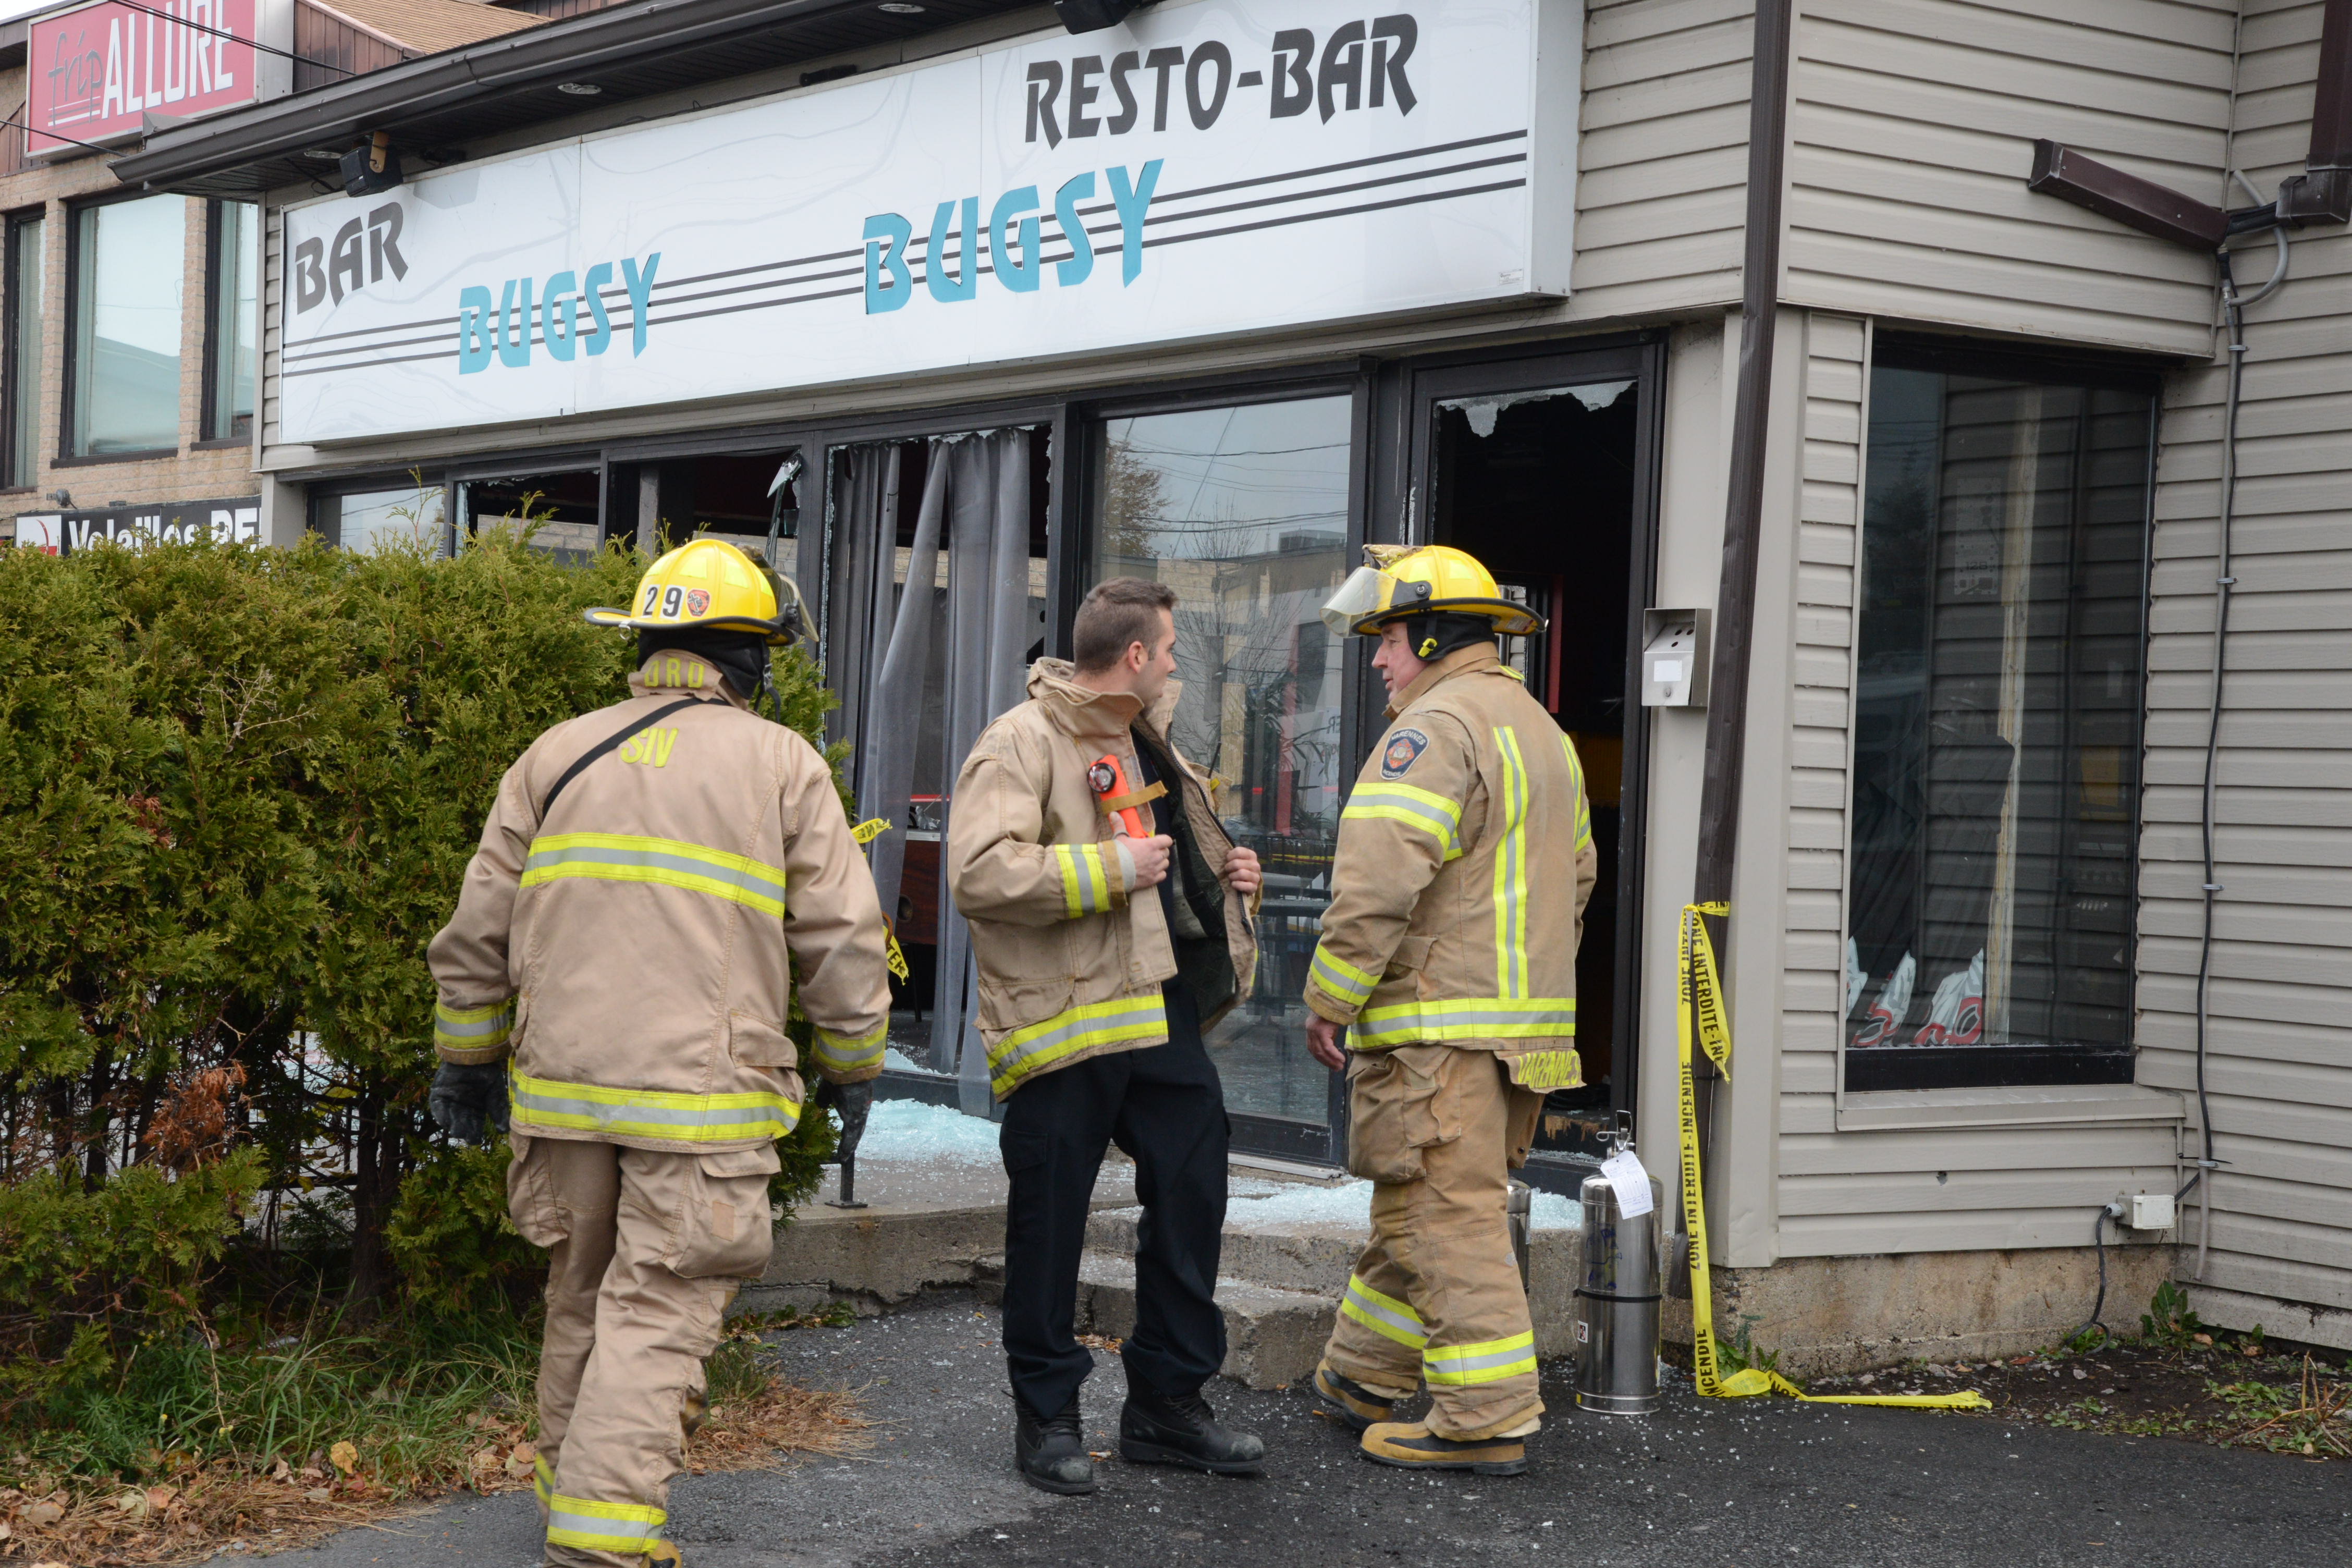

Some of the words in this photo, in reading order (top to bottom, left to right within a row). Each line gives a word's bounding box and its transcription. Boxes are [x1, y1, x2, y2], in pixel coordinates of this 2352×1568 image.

[1025, 14, 1418, 151] RESTO-BAR
[295, 201, 408, 315] BAR
[862, 158, 1165, 315] BUGSY
[459, 252, 661, 375] BUGSY
[643, 586, 682, 617] 29
[1391, 730, 1426, 745] VARENNES
